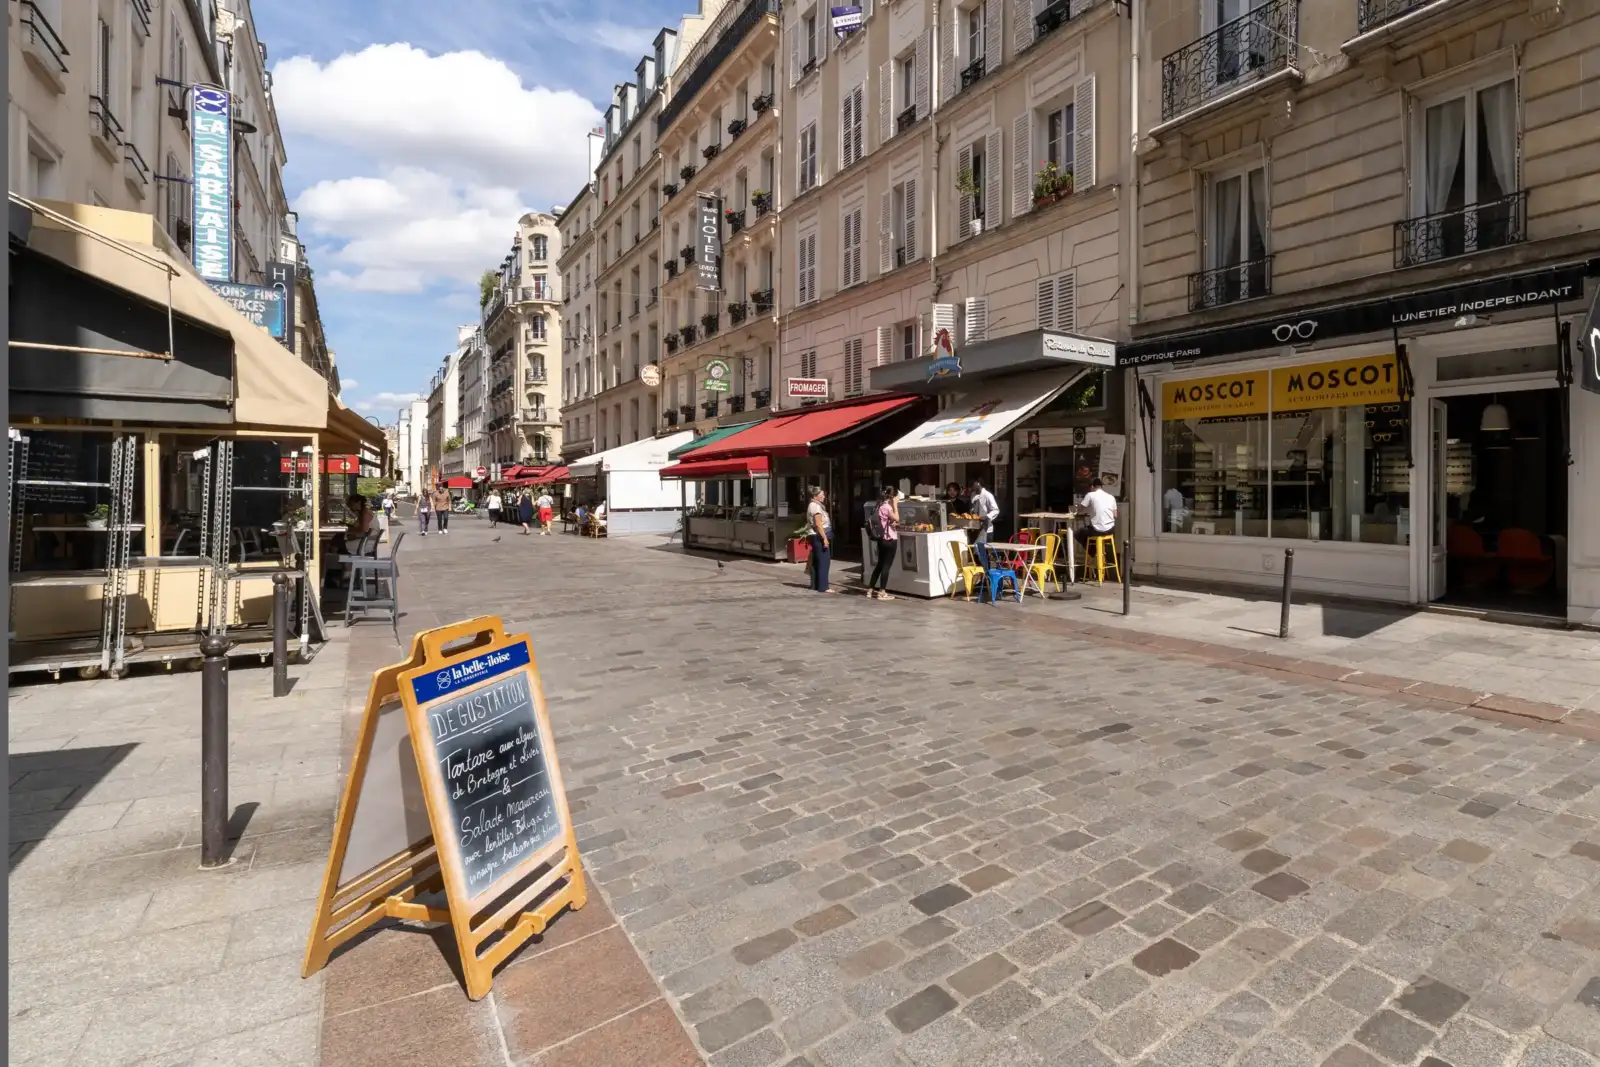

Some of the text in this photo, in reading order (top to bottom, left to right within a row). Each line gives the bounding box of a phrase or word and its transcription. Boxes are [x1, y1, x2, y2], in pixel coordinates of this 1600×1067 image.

[194, 115, 226, 136] LA
[199, 144, 225, 278] SABLAISE
[702, 215, 717, 263] HOTEL
[254, 289, 281, 301] FINS
[1392, 286, 1573, 323] LUNETIER INDEPENDANT
[1120, 347, 1201, 365] ELITE OPTIQUE PARIS
[790, 383, 826, 392] FROMAGER
[1173, 380, 1254, 403] MOSCOT
[1288, 363, 1395, 392] MOSCOT
[452, 652, 511, 680] la belle-iloise
[440, 748, 495, 779] Tartare
[499, 741, 514, 754] aux
[452, 782, 466, 800] de
[467, 768, 508, 794] Bretagne
[509, 754, 518, 770] et
[502, 777, 512, 796] &
[460, 805, 505, 848] Salade
[465, 850, 482, 866] aux
